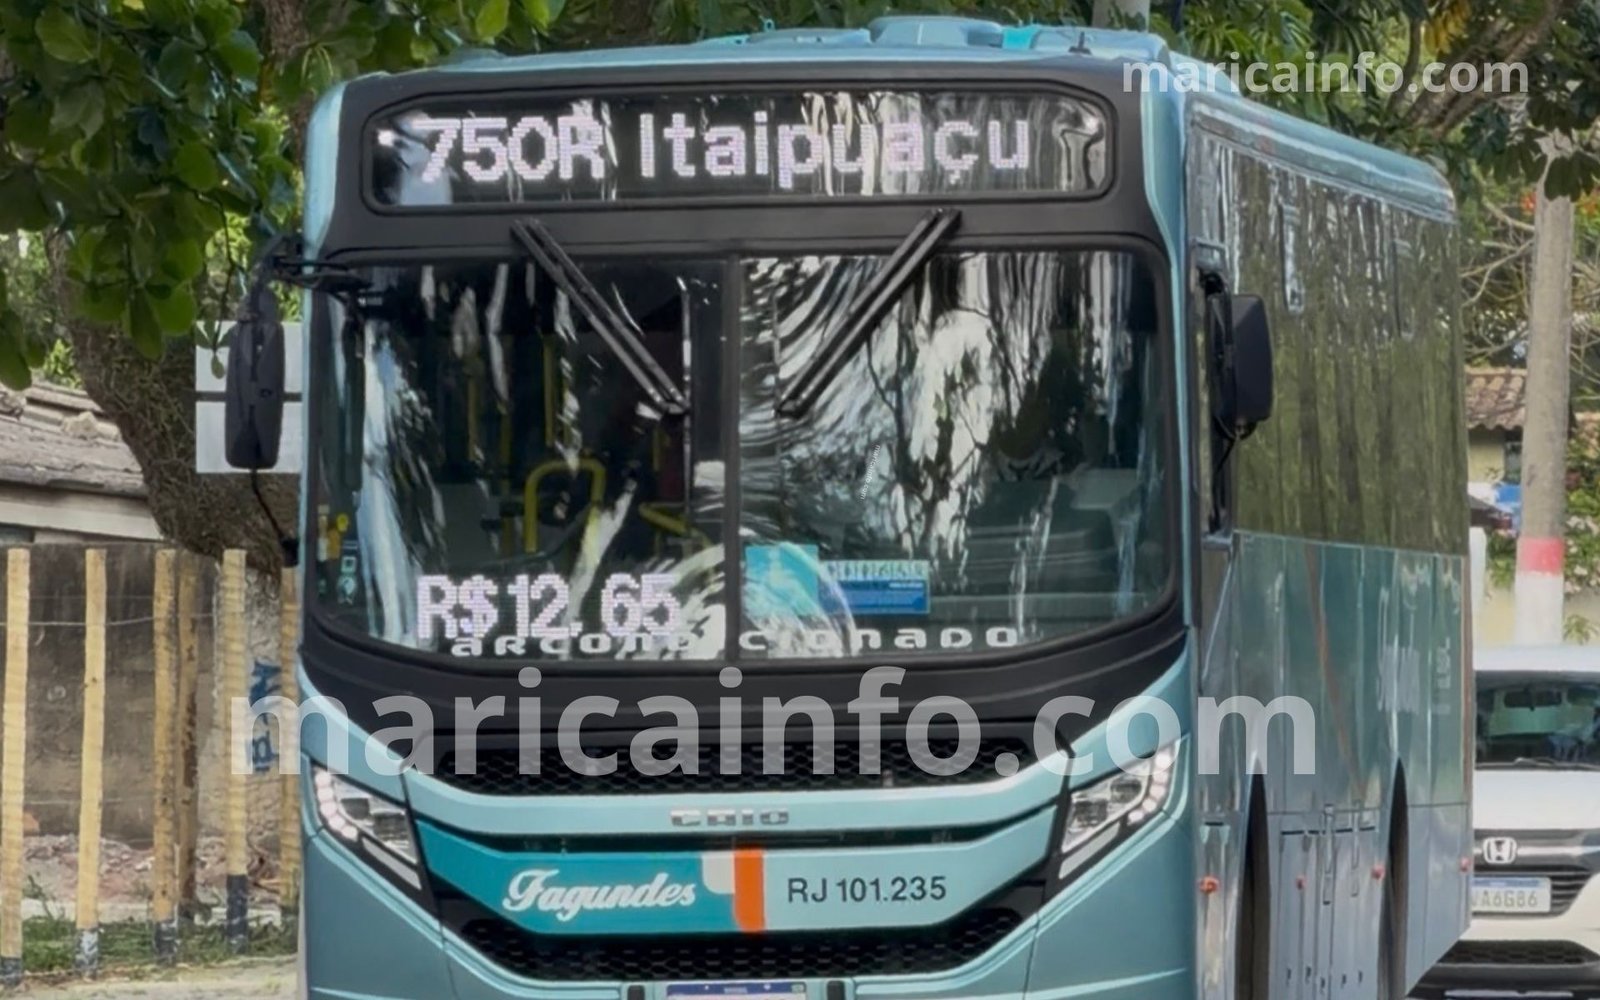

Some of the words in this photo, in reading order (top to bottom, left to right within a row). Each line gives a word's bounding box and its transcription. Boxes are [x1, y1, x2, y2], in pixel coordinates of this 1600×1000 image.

[412, 114, 606, 184] 750R
[638, 111, 1030, 191] Itaipuaçu
[502, 869, 697, 922] Fagundes
[787, 877, 829, 902] RJ
[836, 876, 948, 903] 101.235
